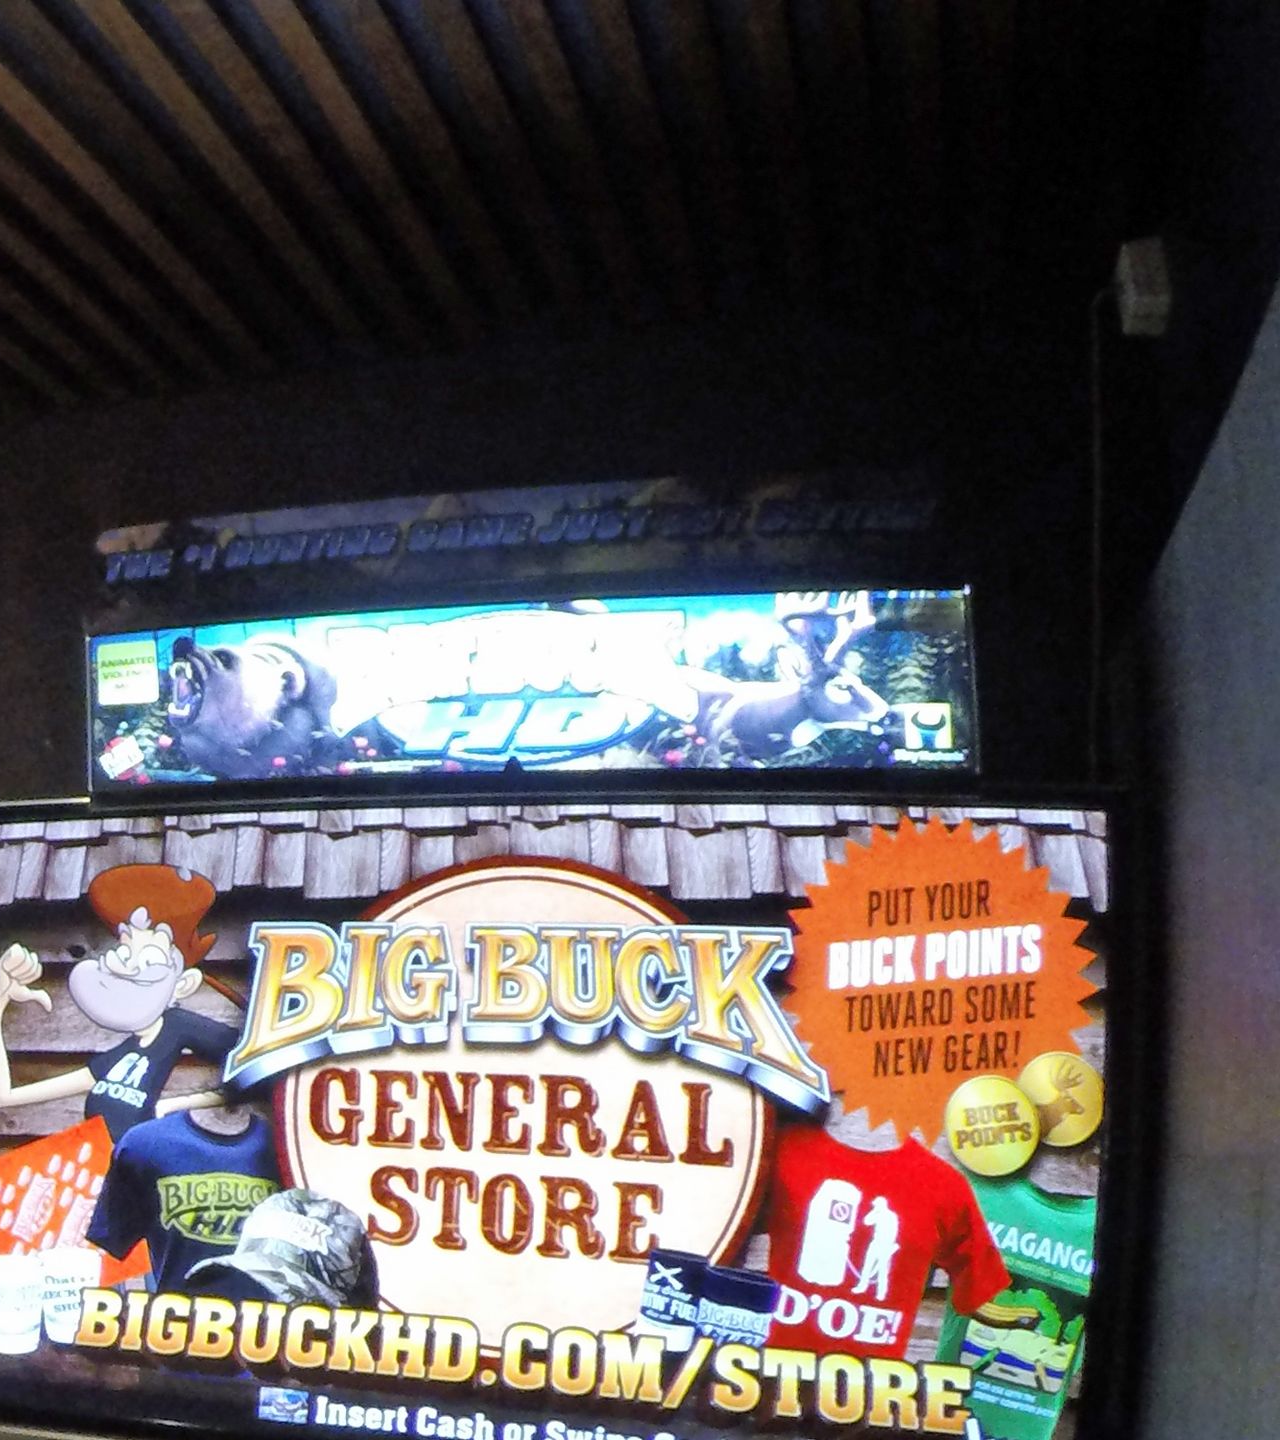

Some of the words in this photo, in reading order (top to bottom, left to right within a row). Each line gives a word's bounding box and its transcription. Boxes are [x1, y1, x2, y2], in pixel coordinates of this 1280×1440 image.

[100, 656, 155, 669] ANIMATED
[102, 668, 151, 680] VIOLEN
[868, 890, 913, 927] PUT
[920, 881, 992, 922] YOUR
[828, 938, 916, 991] BUCK
[925, 926, 1042, 982] POINTS
[227, 922, 454, 1077] BIG
[467, 922, 829, 1105] BUCK
[845, 990, 955, 1034] TOWARD
[964, 981, 1038, 1025] SOME
[872, 1037, 931, 1077] NEW
[945, 1033, 1022, 1070] GEAR!
[308, 1067, 736, 1168] GENERAL
[956, 1122, 1032, 1150] POINTS
[964, 1102, 1020, 1126] BUCK
[164, 1181, 209, 1214] BIG
[366, 1166, 664, 1263] STORE
[776, 1284, 904, 1346] D'OE!
[74, 1288, 975, 1438] BIGBUCKHD.COM/STORE
[316, 1395, 408, 1436] Insert
